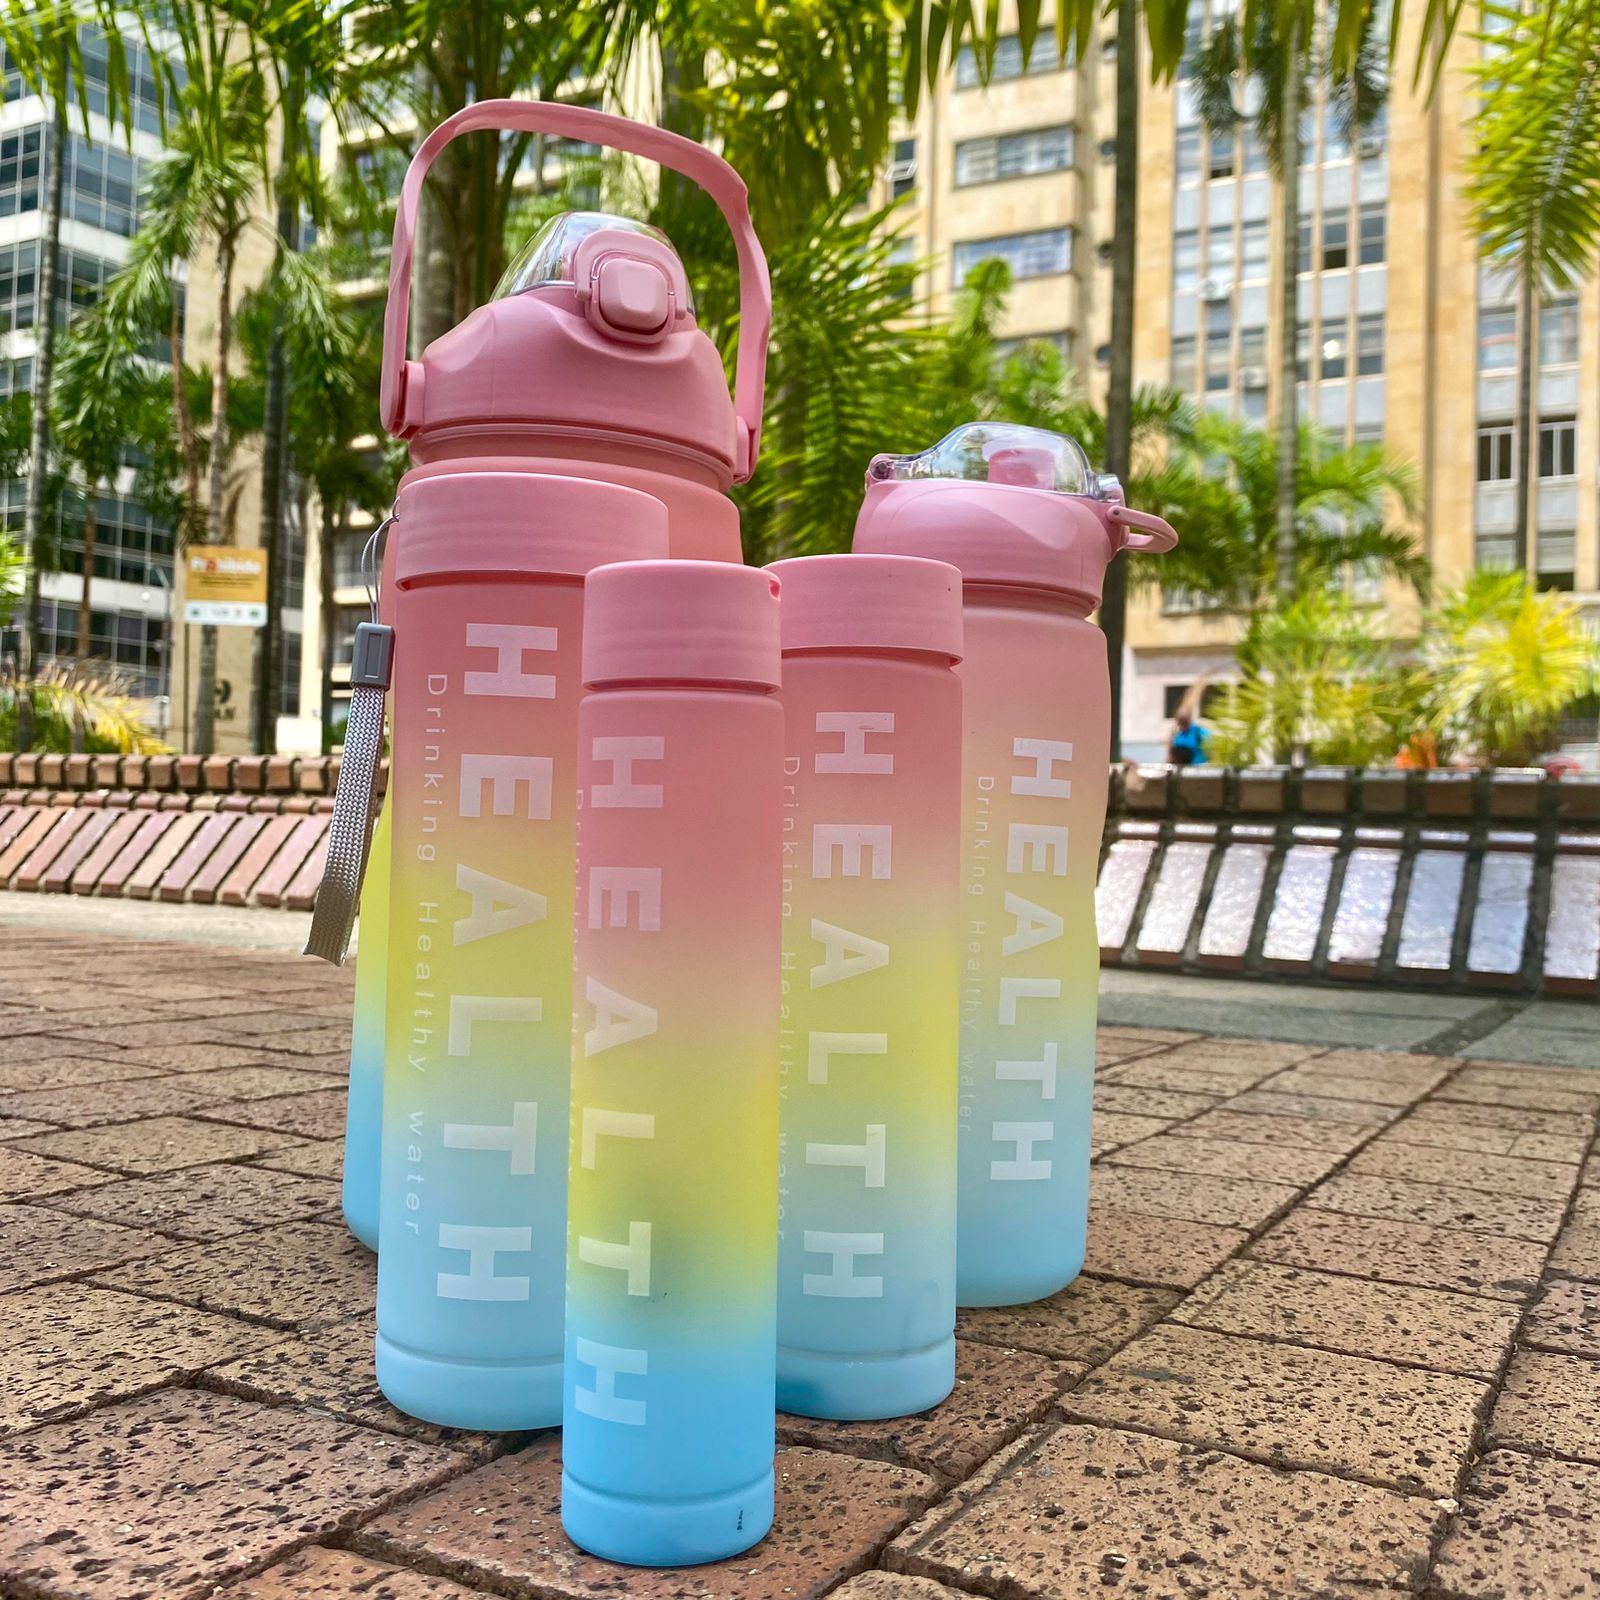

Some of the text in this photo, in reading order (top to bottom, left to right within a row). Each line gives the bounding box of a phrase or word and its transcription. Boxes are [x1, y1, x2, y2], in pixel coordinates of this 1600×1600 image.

[405, 674, 448, 1234] Drinking Healthy water
[437, 623, 558, 1301] HEALTH
[575, 736, 665, 1426] HEALTH
[803, 712, 895, 1298] HEALTH
[959, 776, 995, 1132] Drinking Healthy water
[990, 737, 1073, 1180] HEALTH
